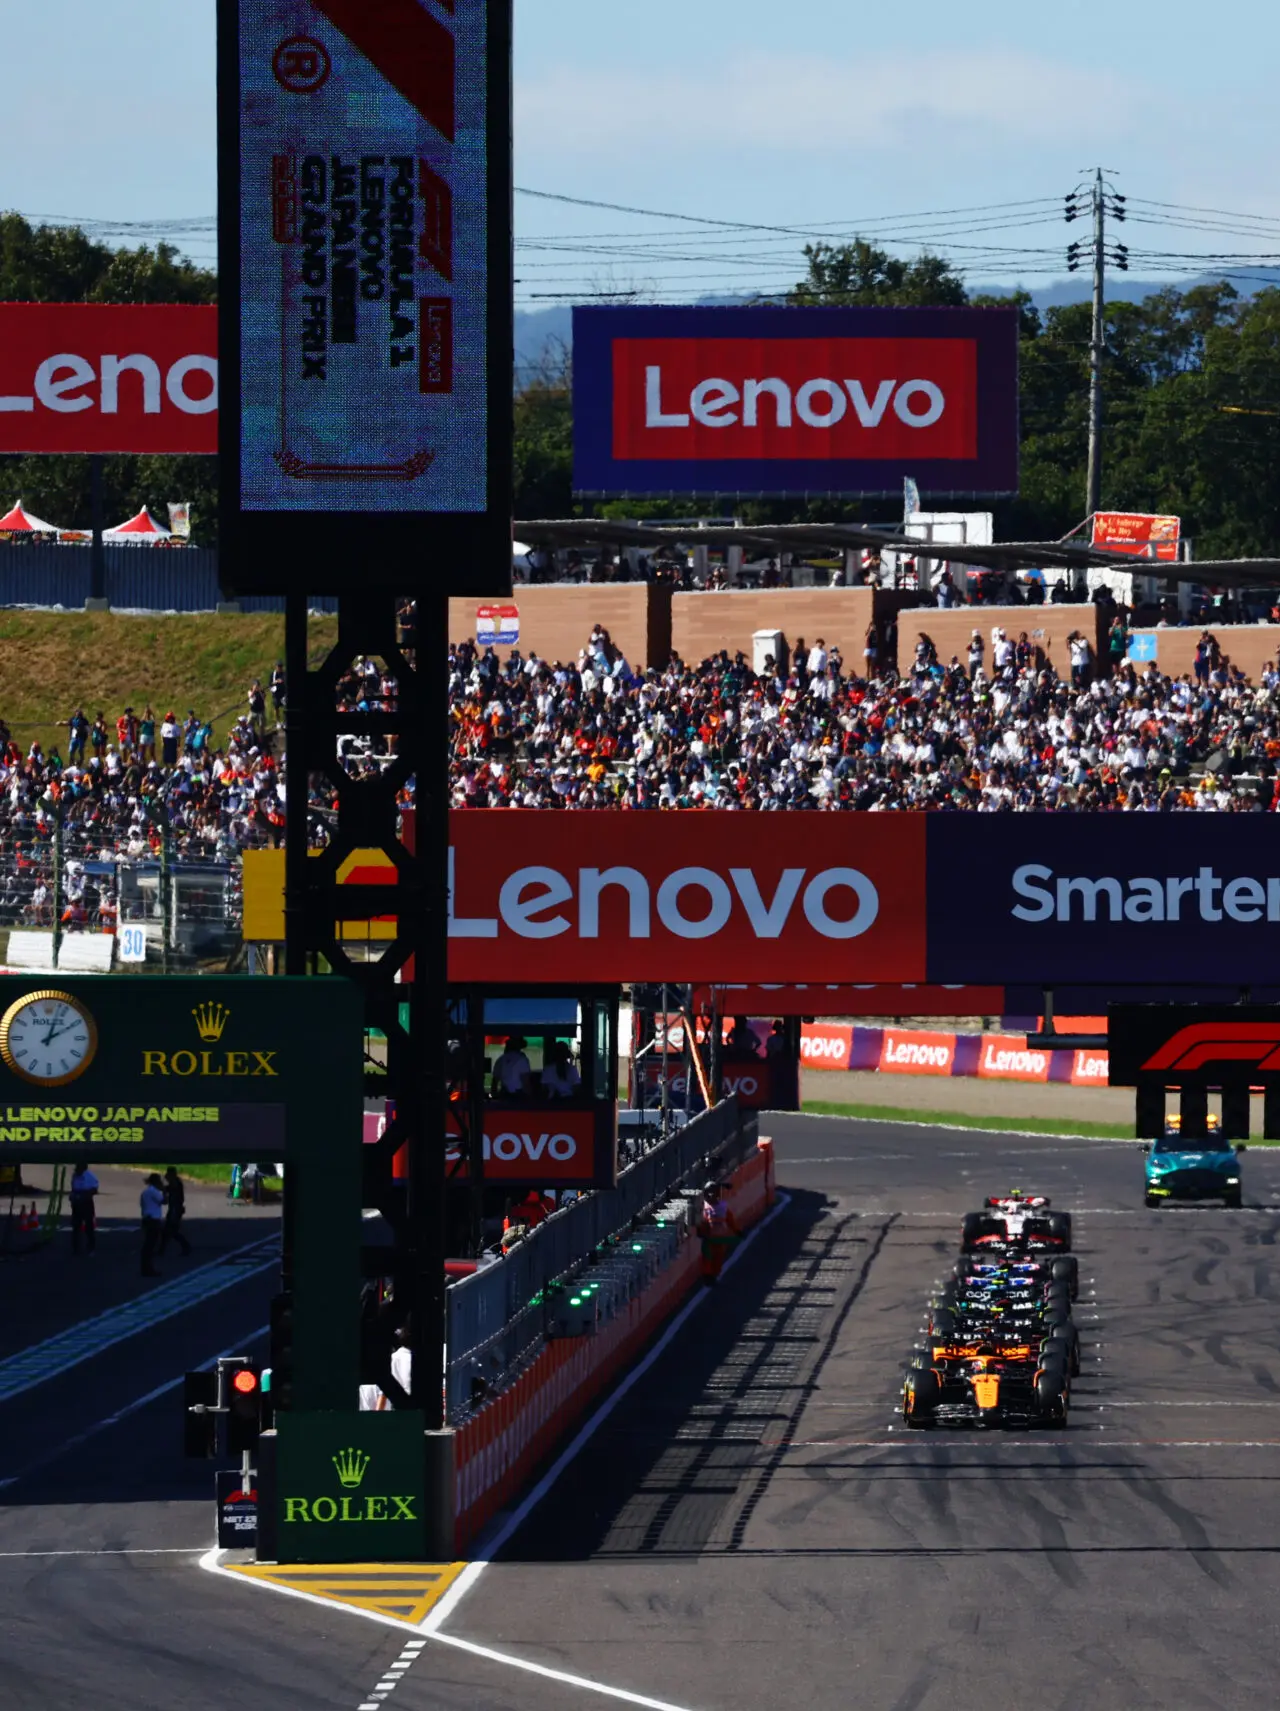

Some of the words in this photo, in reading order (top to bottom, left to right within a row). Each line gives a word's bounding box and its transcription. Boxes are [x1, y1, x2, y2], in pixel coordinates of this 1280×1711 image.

[361, 156, 385, 300] LENOVO
[301, 295, 326, 381] PRIX
[646, 365, 944, 428] Lenovo
[448, 846, 879, 939] Lenovo
[124, 929, 143, 956] 30
[141, 1050, 278, 1076] ROLEX
[885, 1038, 949, 1067] Lenovo
[984, 1045, 1046, 1072] Lenovo
[7, 1107, 99, 1122] LENOVO
[102, 1107, 219, 1122] JAPANESE
[0, 1127, 31, 1142] ND
[34, 1127, 87, 1142] PRIX
[90, 1127, 144, 1142] 2023
[284, 1496, 417, 1522] ROLEX
